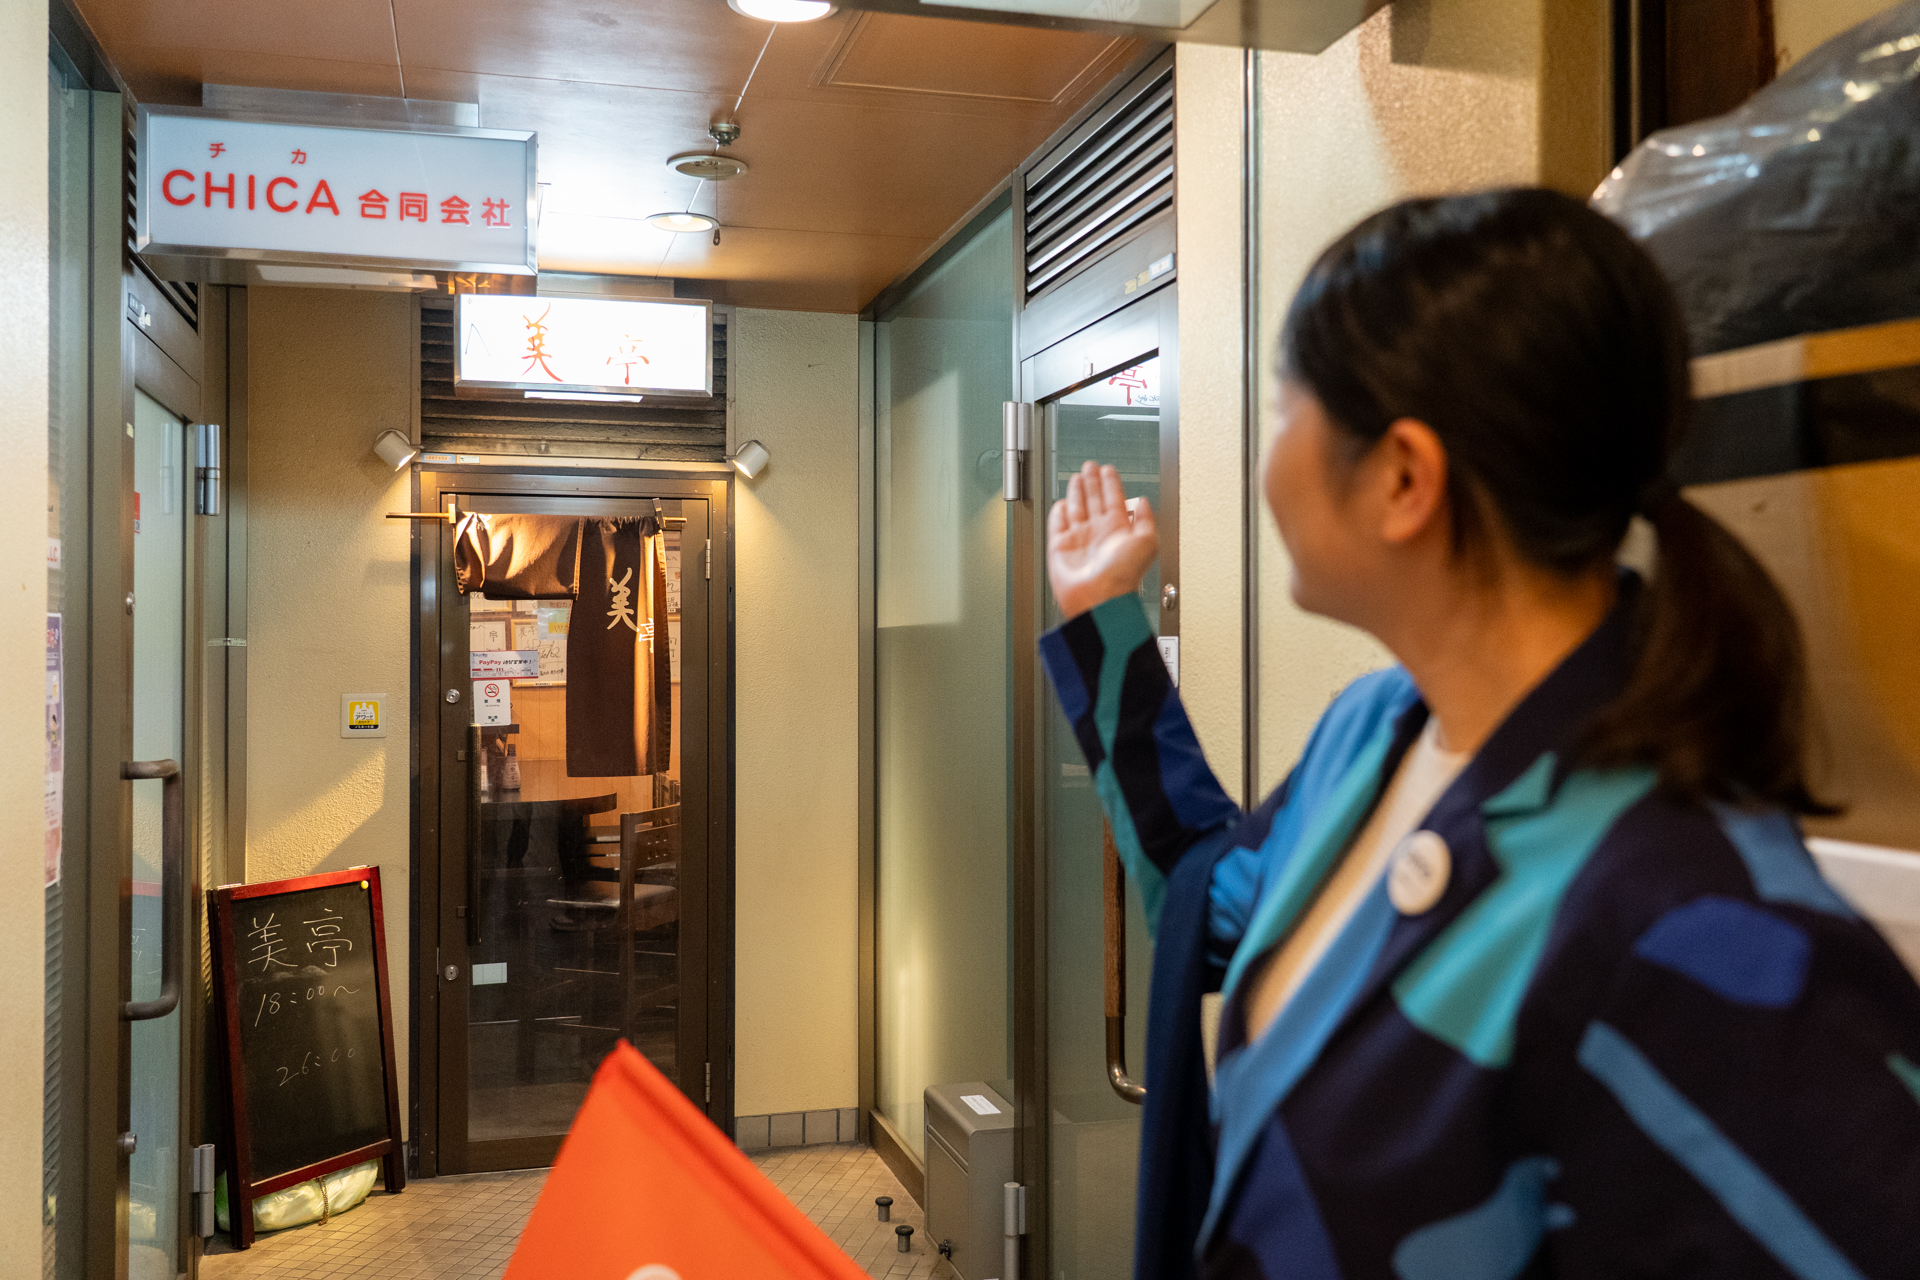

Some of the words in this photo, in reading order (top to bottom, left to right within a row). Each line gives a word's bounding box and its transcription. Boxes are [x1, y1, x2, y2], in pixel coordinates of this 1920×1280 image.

[161, 169, 340, 216] CHICA
[358, 188, 512, 229] 合同会社
[521, 301, 650, 385] 美亭
[247, 907, 354, 973] 美亭
